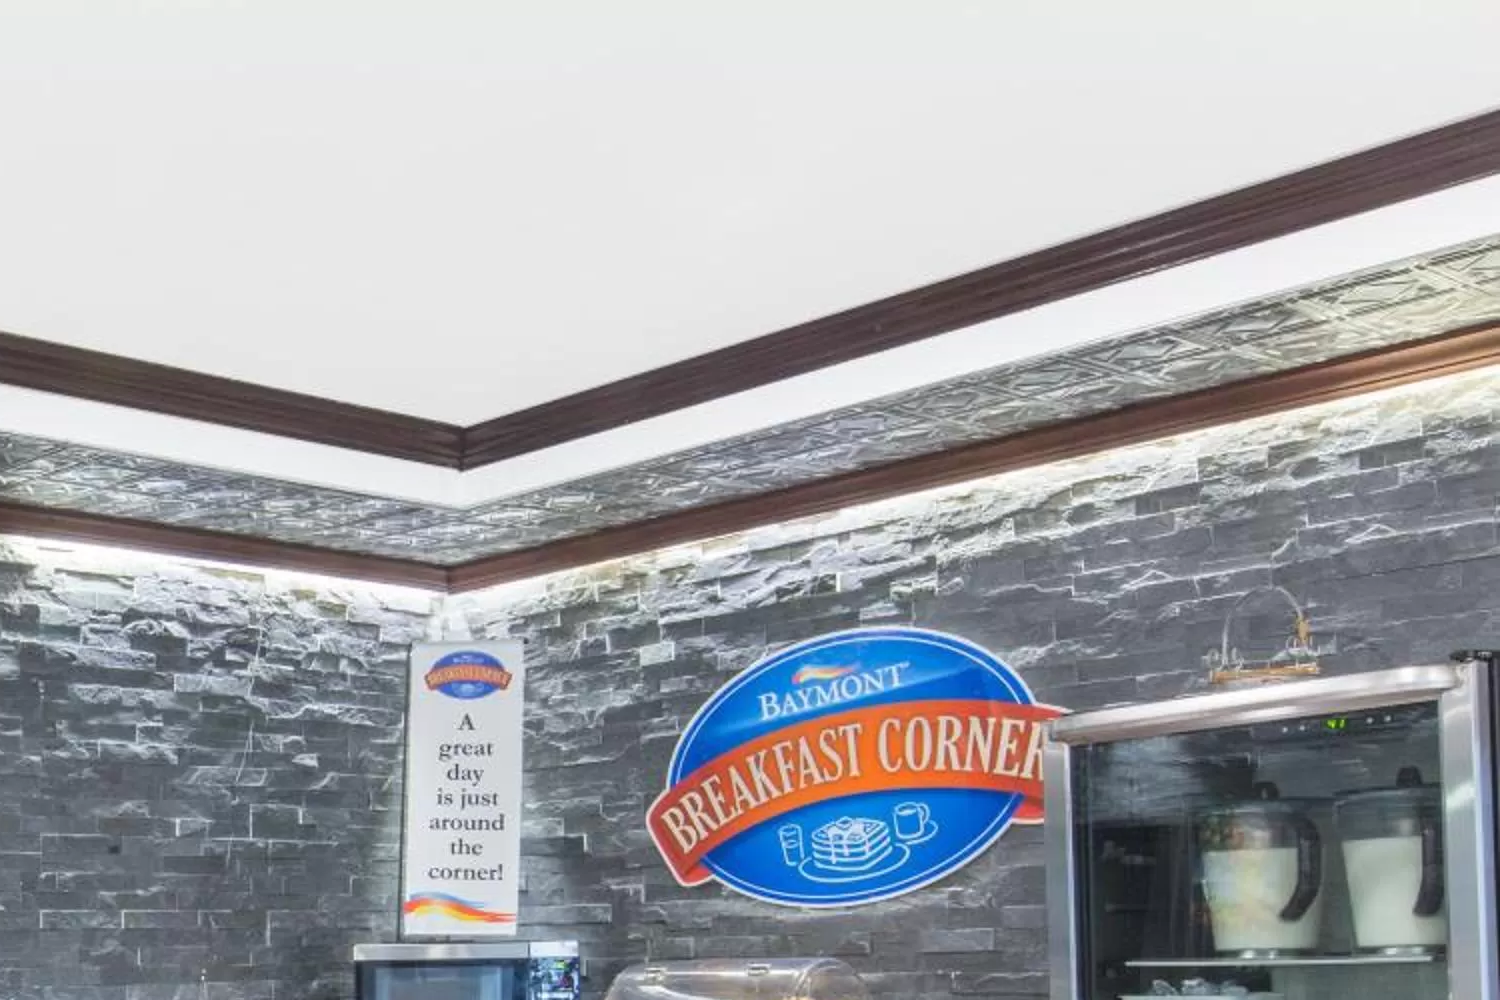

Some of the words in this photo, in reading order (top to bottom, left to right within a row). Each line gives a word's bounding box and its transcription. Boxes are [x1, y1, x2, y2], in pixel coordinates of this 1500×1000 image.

[757, 662, 909, 721] BAYMONT
[457, 713, 476, 731] A
[438, 743, 494, 761] great
[446, 763, 484, 786] day
[660, 723, 863, 854] BREAKFAST
[436, 787, 453, 806] is
[460, 788, 499, 810] just
[428, 813, 505, 831] around
[450, 838, 483, 856] the
[427, 863, 504, 881] corner!
